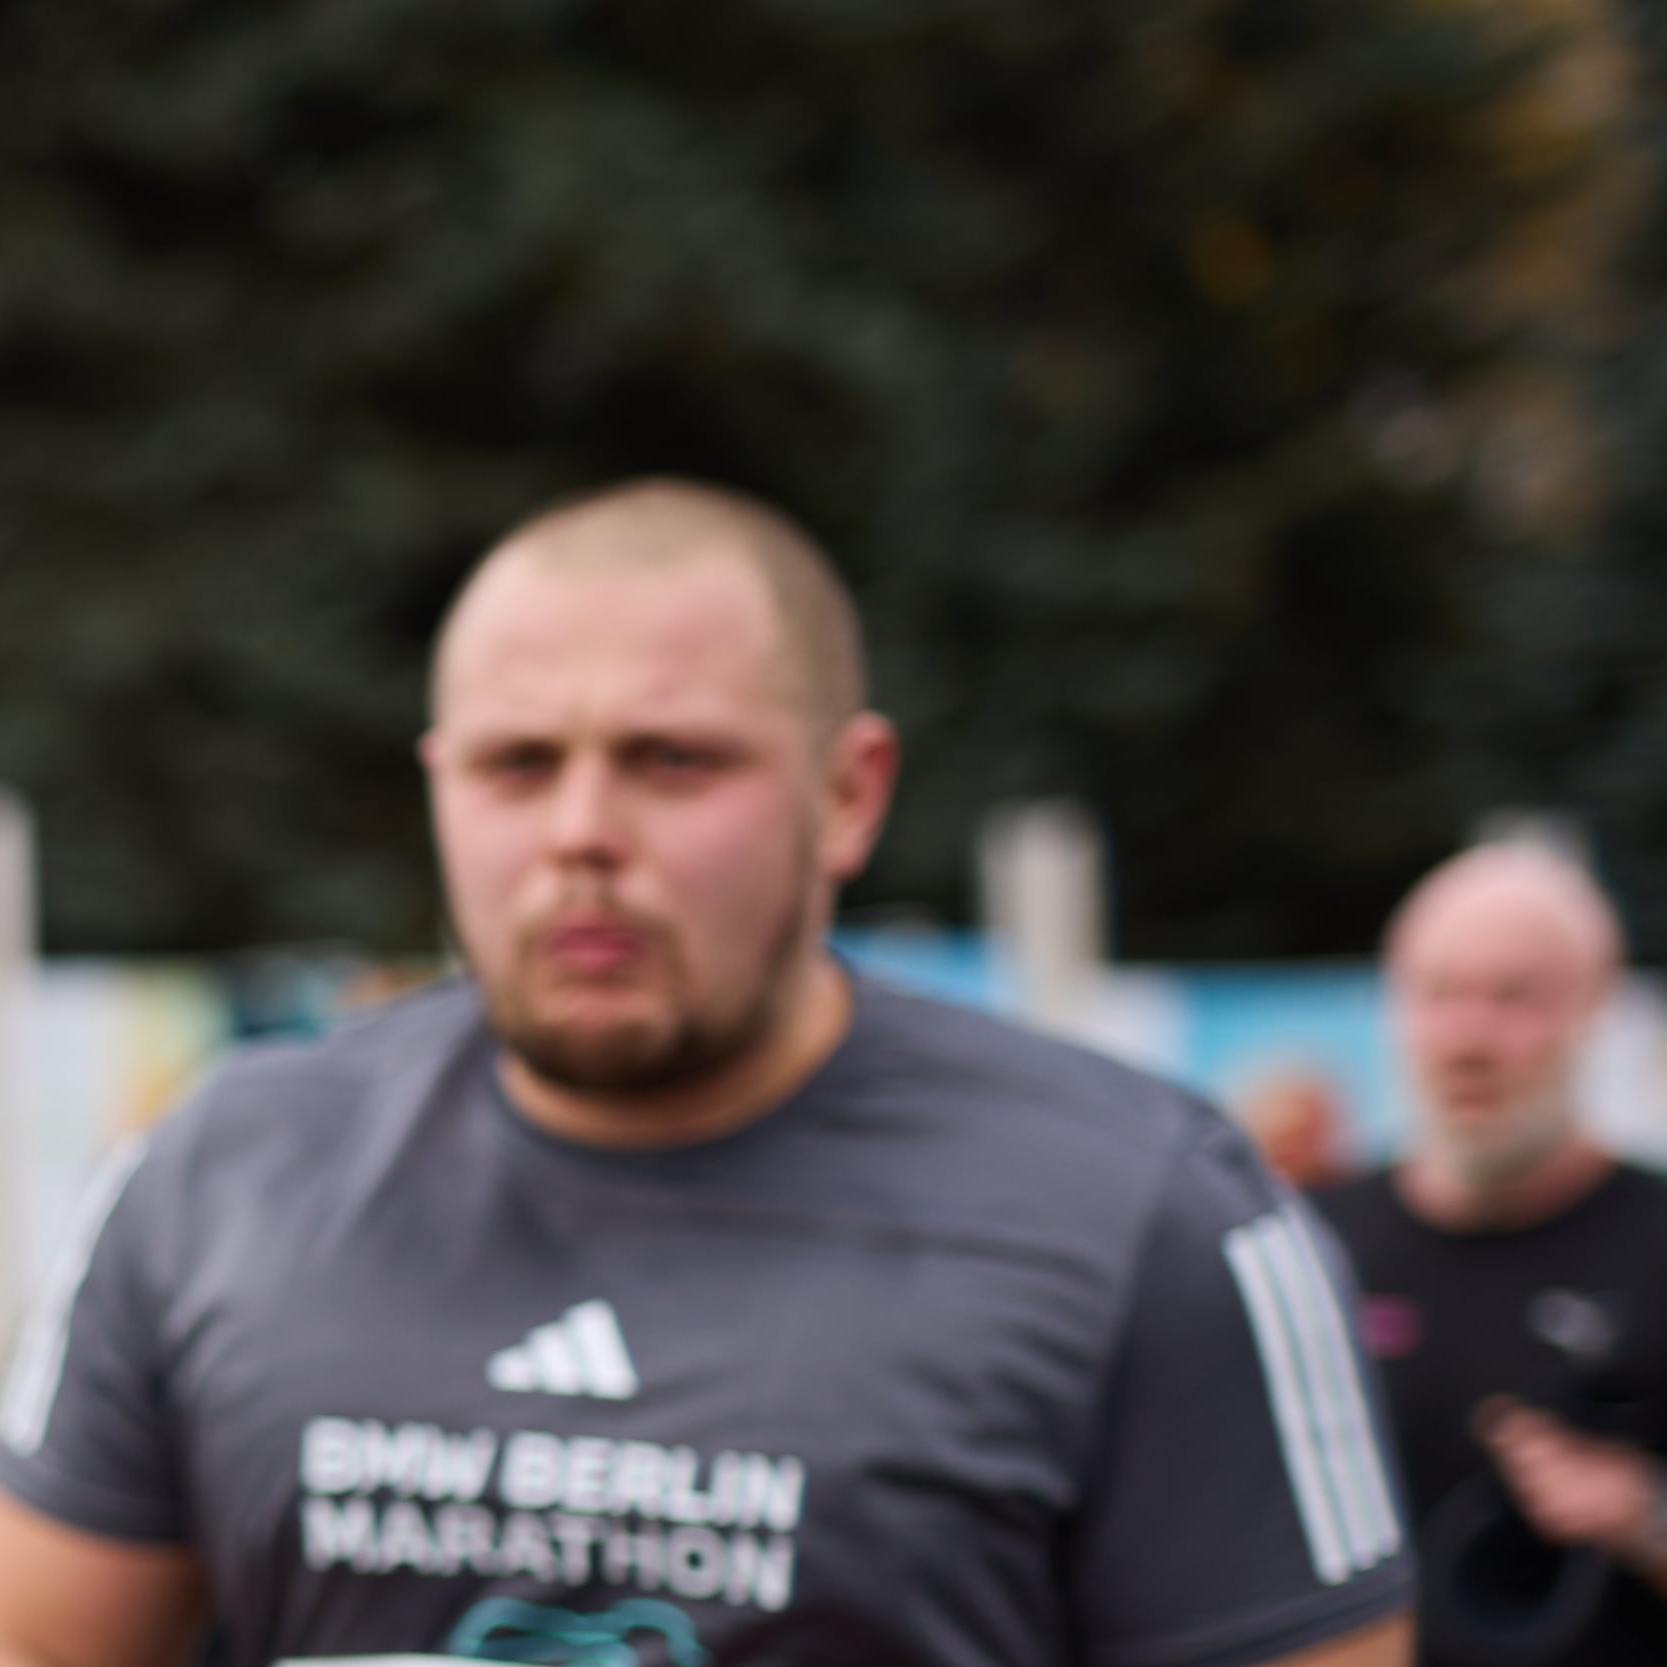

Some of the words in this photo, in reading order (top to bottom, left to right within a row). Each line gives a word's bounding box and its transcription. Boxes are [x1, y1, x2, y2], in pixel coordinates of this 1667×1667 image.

[301, 1416, 497, 1501] BMW
[500, 1429, 805, 1532] BERLIN
[302, 1498, 795, 1611] MARATHON
